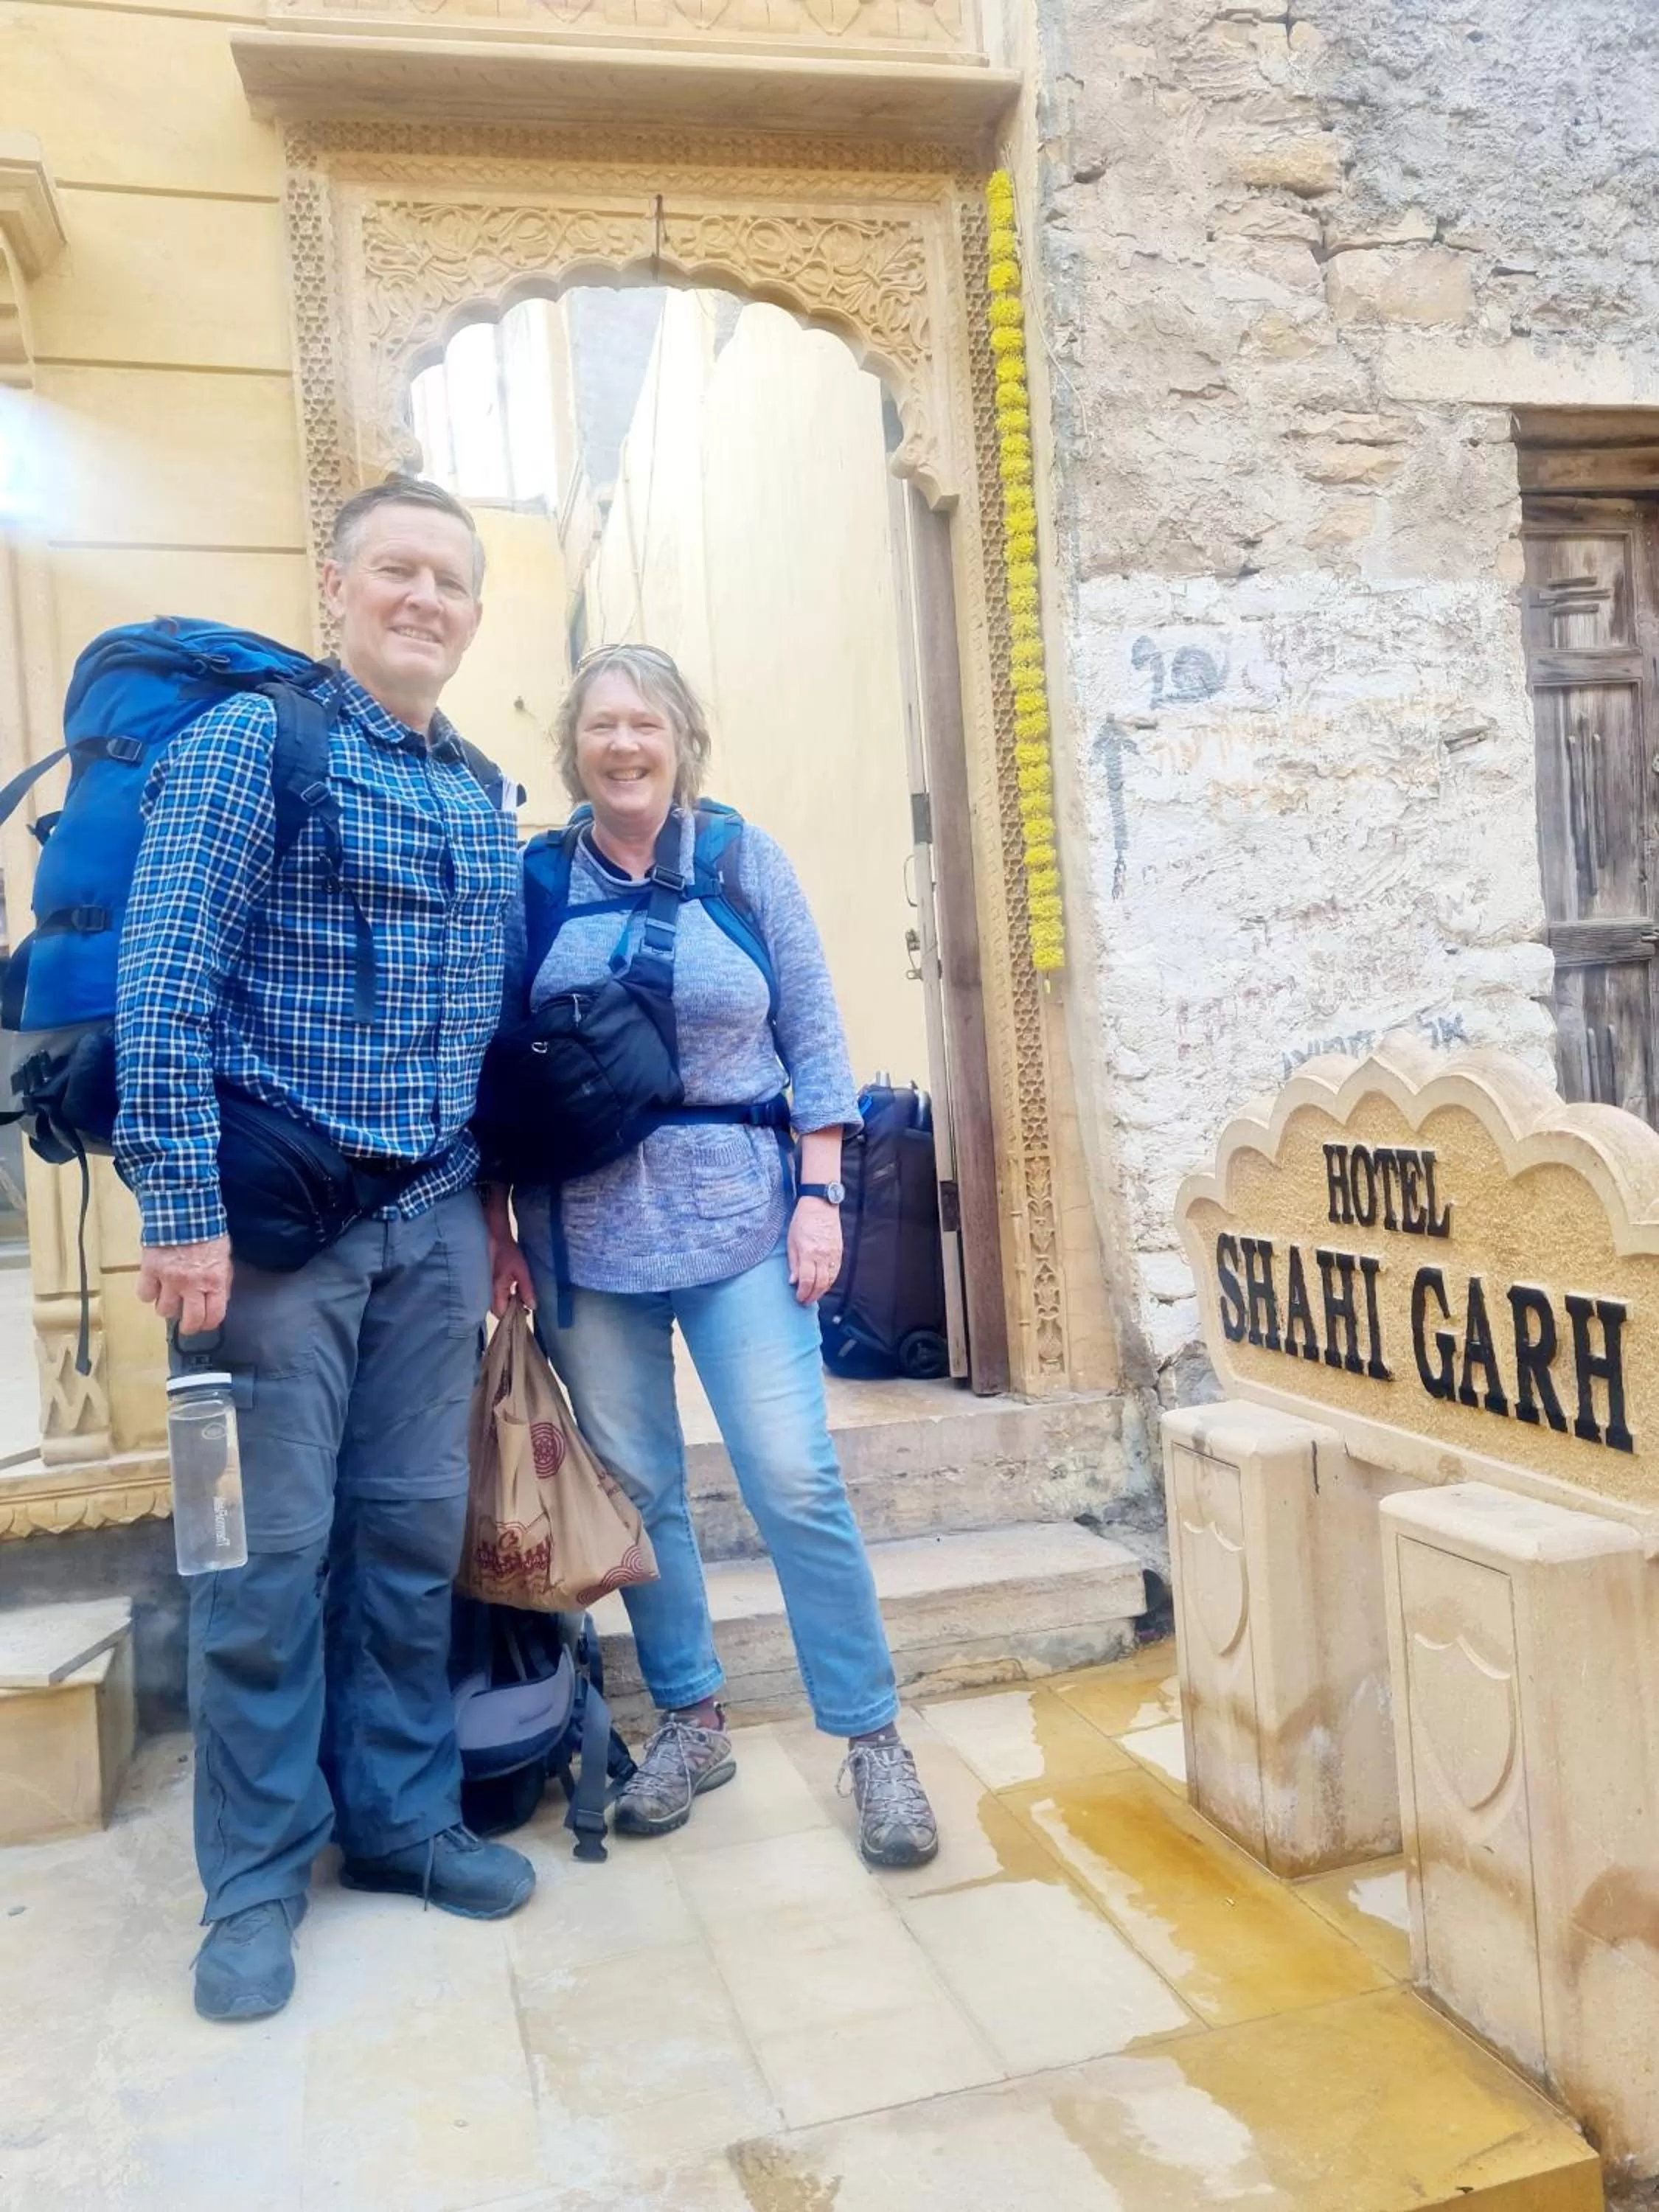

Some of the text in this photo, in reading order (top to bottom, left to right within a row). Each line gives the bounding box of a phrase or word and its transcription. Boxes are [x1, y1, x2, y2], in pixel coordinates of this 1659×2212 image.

[1323, 1144, 1452, 1237] HOTEL
[1217, 1233, 1634, 1454] SHAHI GARH
